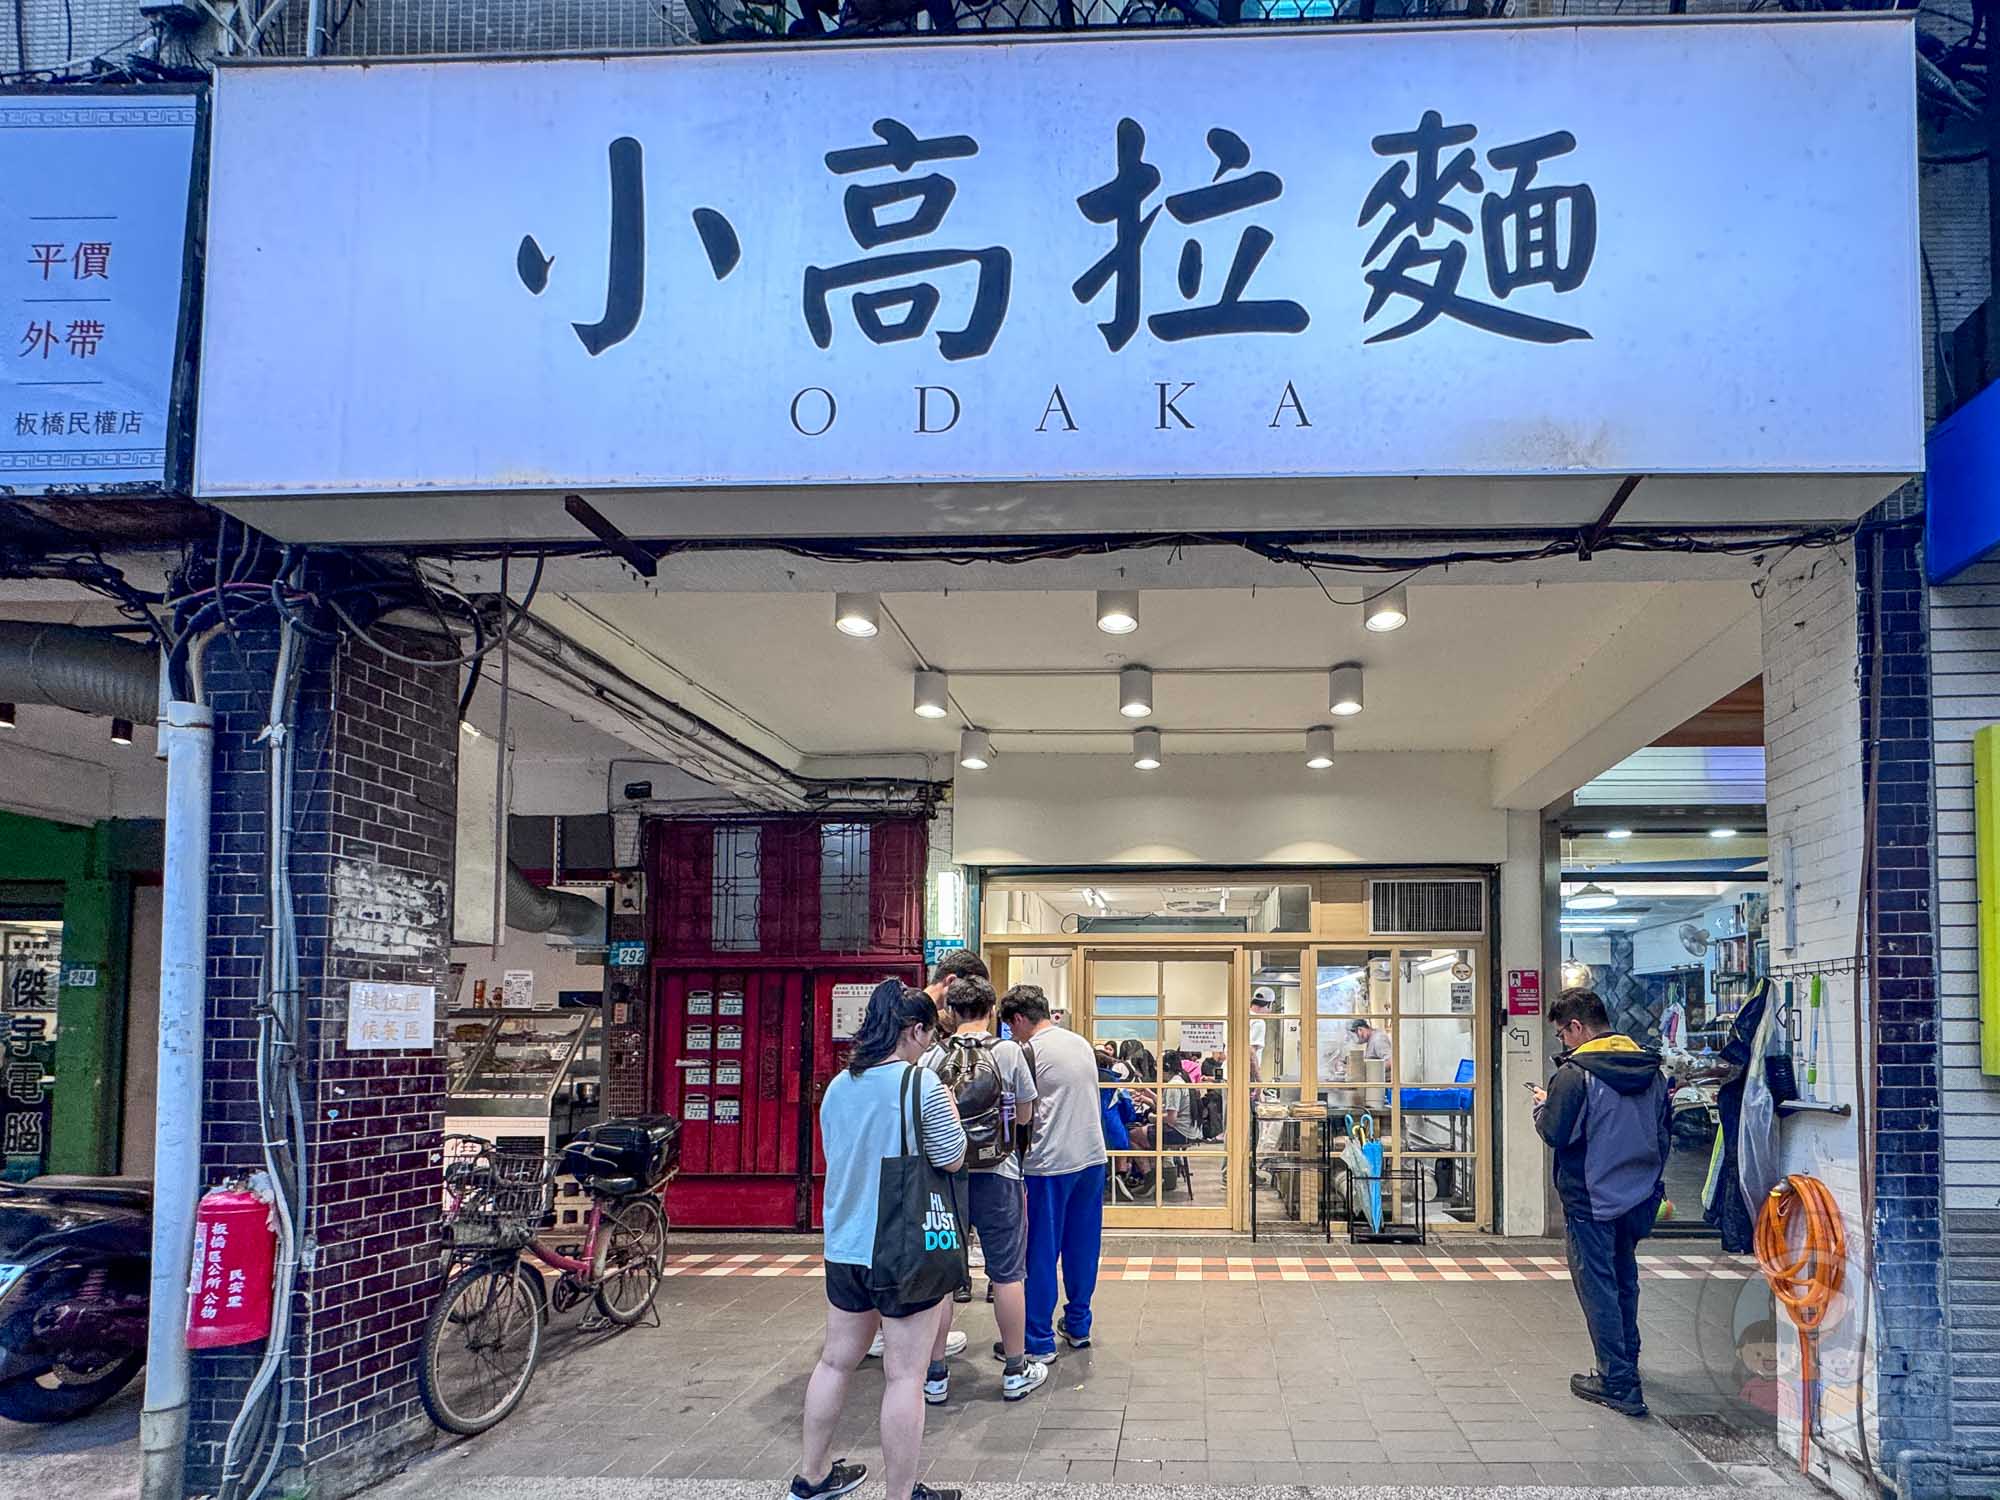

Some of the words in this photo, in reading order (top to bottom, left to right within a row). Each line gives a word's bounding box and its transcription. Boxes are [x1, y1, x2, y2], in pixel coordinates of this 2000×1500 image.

[517, 110, 1598, 361] 小高拉麵
[27, 241, 112, 281] 平價
[19, 320, 105, 360] 外帶
[14, 410, 144, 437] 板橋民權店
[790, 380, 1313, 436] ODAKA
[621, 949, 644, 963] 292
[70, 971, 95, 985] 294
[4, 966, 49, 1155] 傑宇電腦
[921, 1211, 956, 1231] JUST
